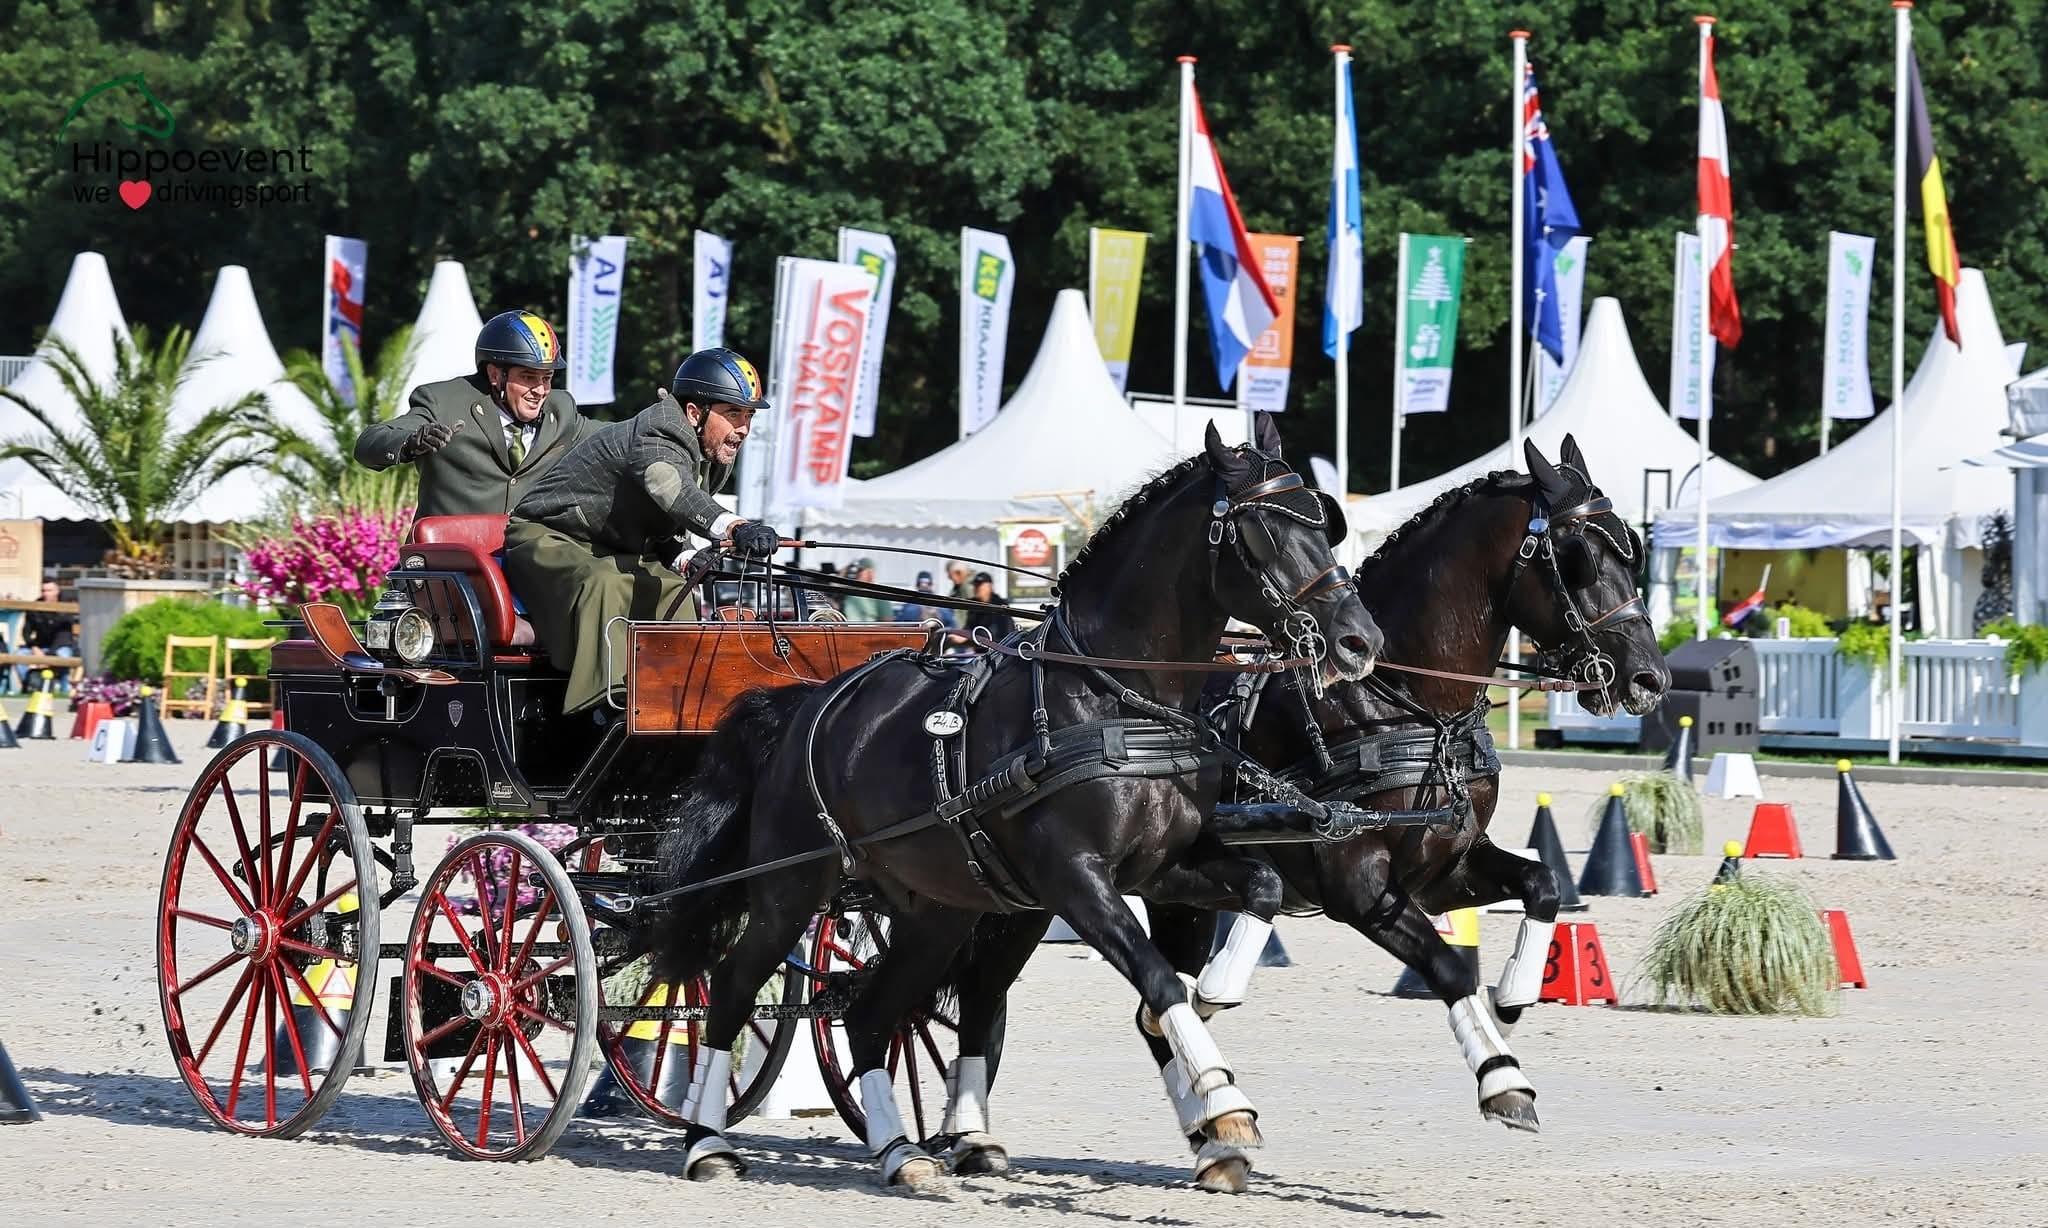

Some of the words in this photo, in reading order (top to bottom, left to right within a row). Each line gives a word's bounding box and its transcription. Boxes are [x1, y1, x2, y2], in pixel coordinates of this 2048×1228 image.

[593, 257, 618, 298] AJ
[792, 341, 823, 421] HALL
[808, 287, 870, 485] VOSKAMP
[1584, 941, 1604, 986] 3
